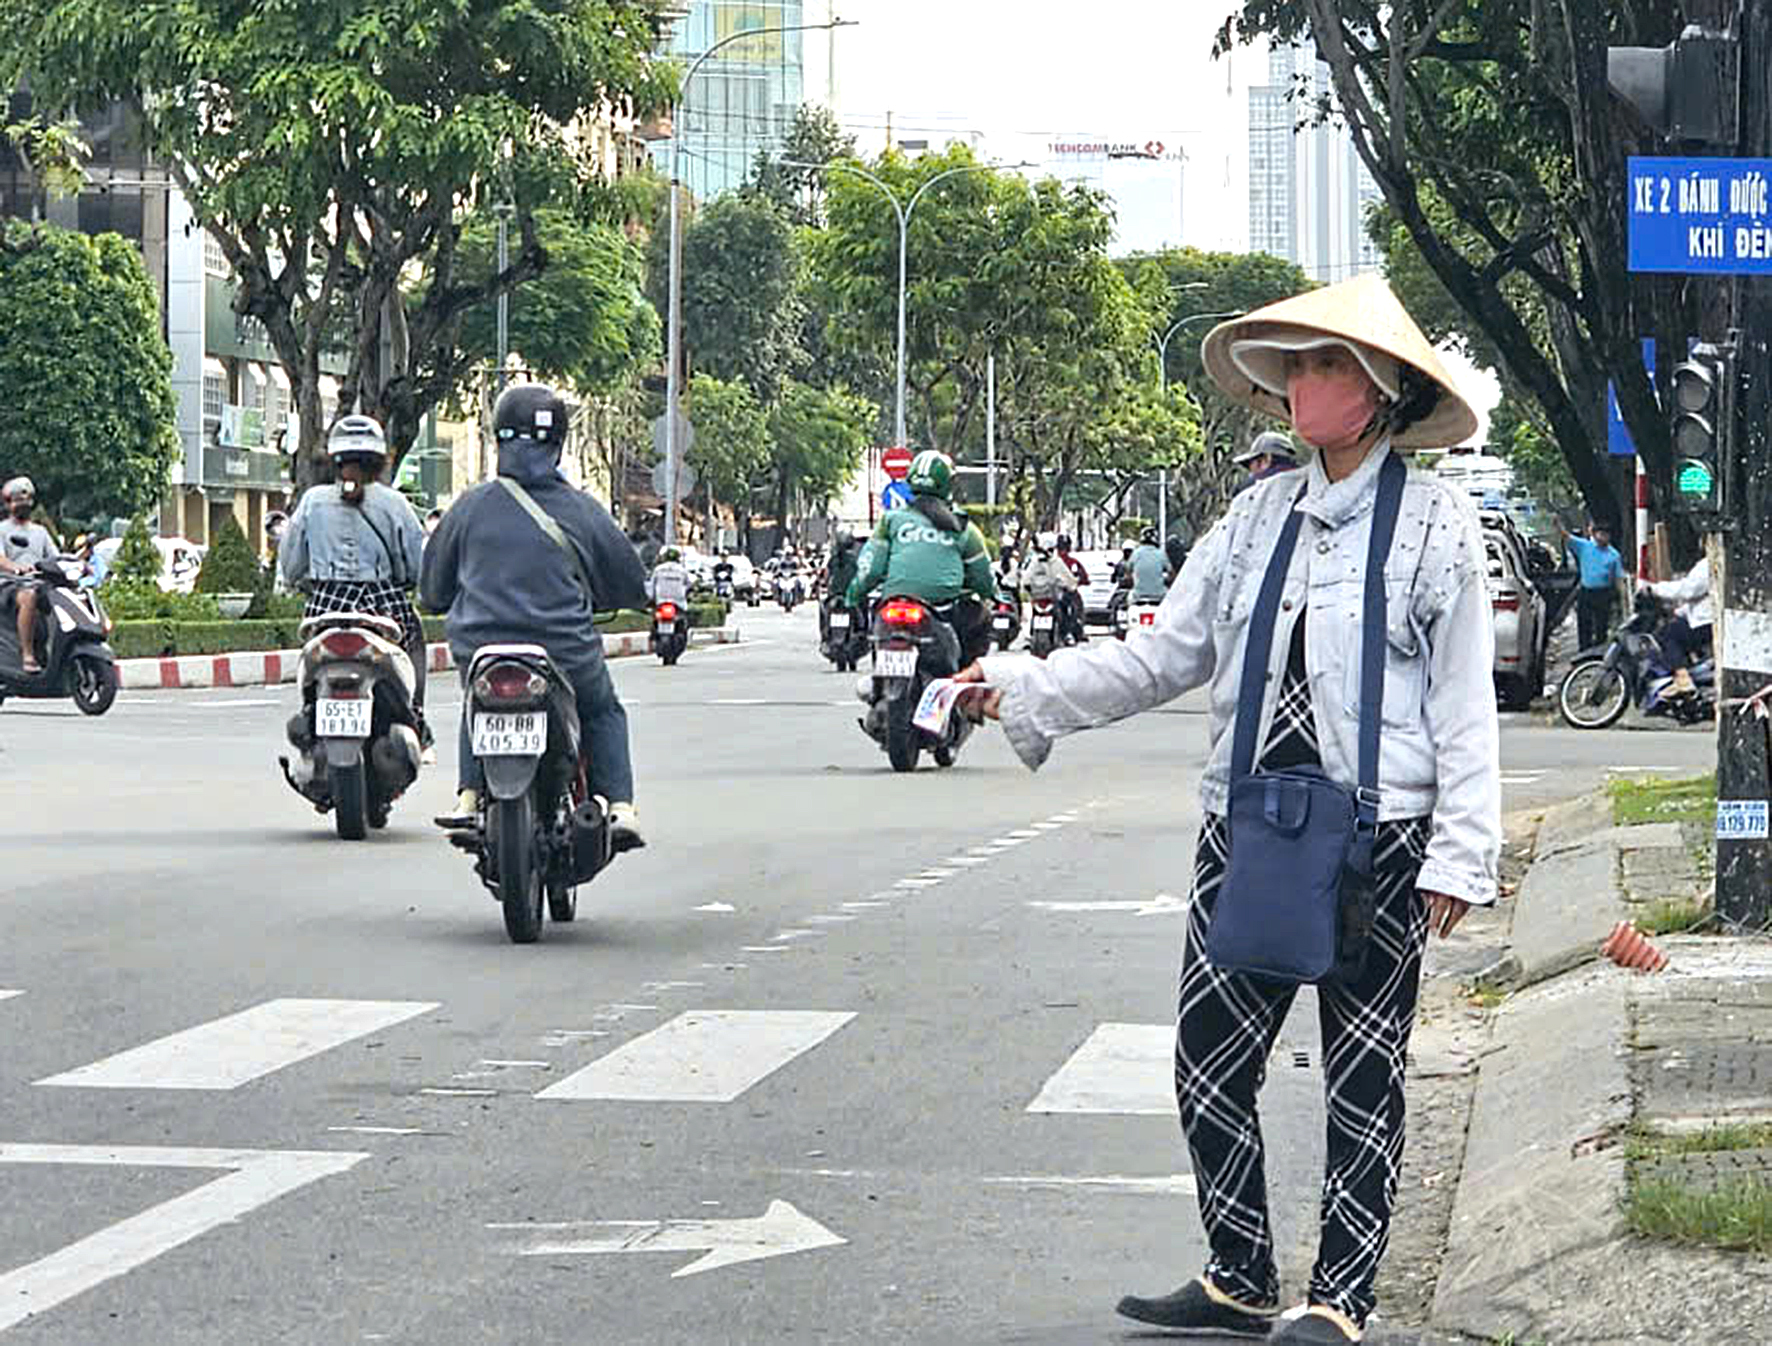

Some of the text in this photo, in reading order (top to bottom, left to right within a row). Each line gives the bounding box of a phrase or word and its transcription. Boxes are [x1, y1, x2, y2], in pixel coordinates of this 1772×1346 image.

[1635, 176, 1654, 213] XE
[1660, 176, 1671, 213] 2
[1679, 171, 1719, 213] BÁNH
